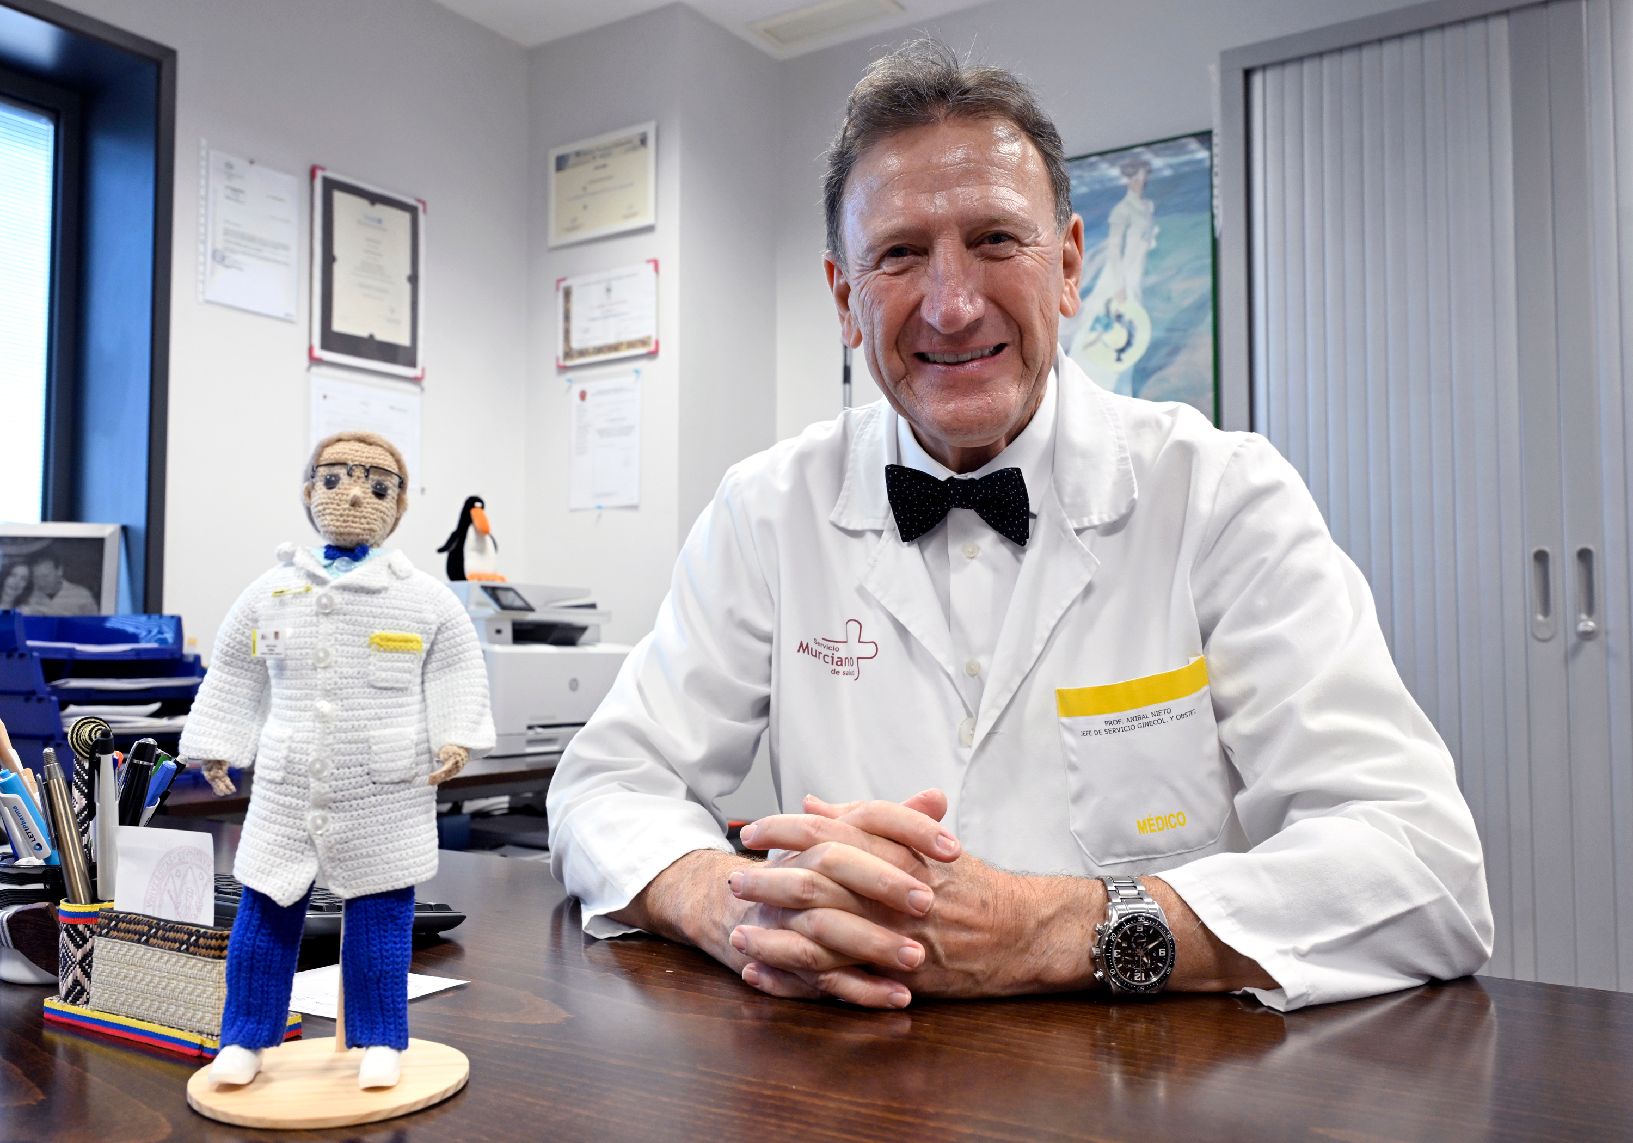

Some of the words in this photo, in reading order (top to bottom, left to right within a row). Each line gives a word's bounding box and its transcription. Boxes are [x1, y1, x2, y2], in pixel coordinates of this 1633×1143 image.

[813, 638, 840, 653] Servicio
[796, 640, 855, 667] Murciano
[830, 668, 840, 676] de
[1104, 718, 1125, 727] PROF.
[1150, 707, 1172, 718] NIETO
[1104, 724, 1136, 735] SERVICIO
